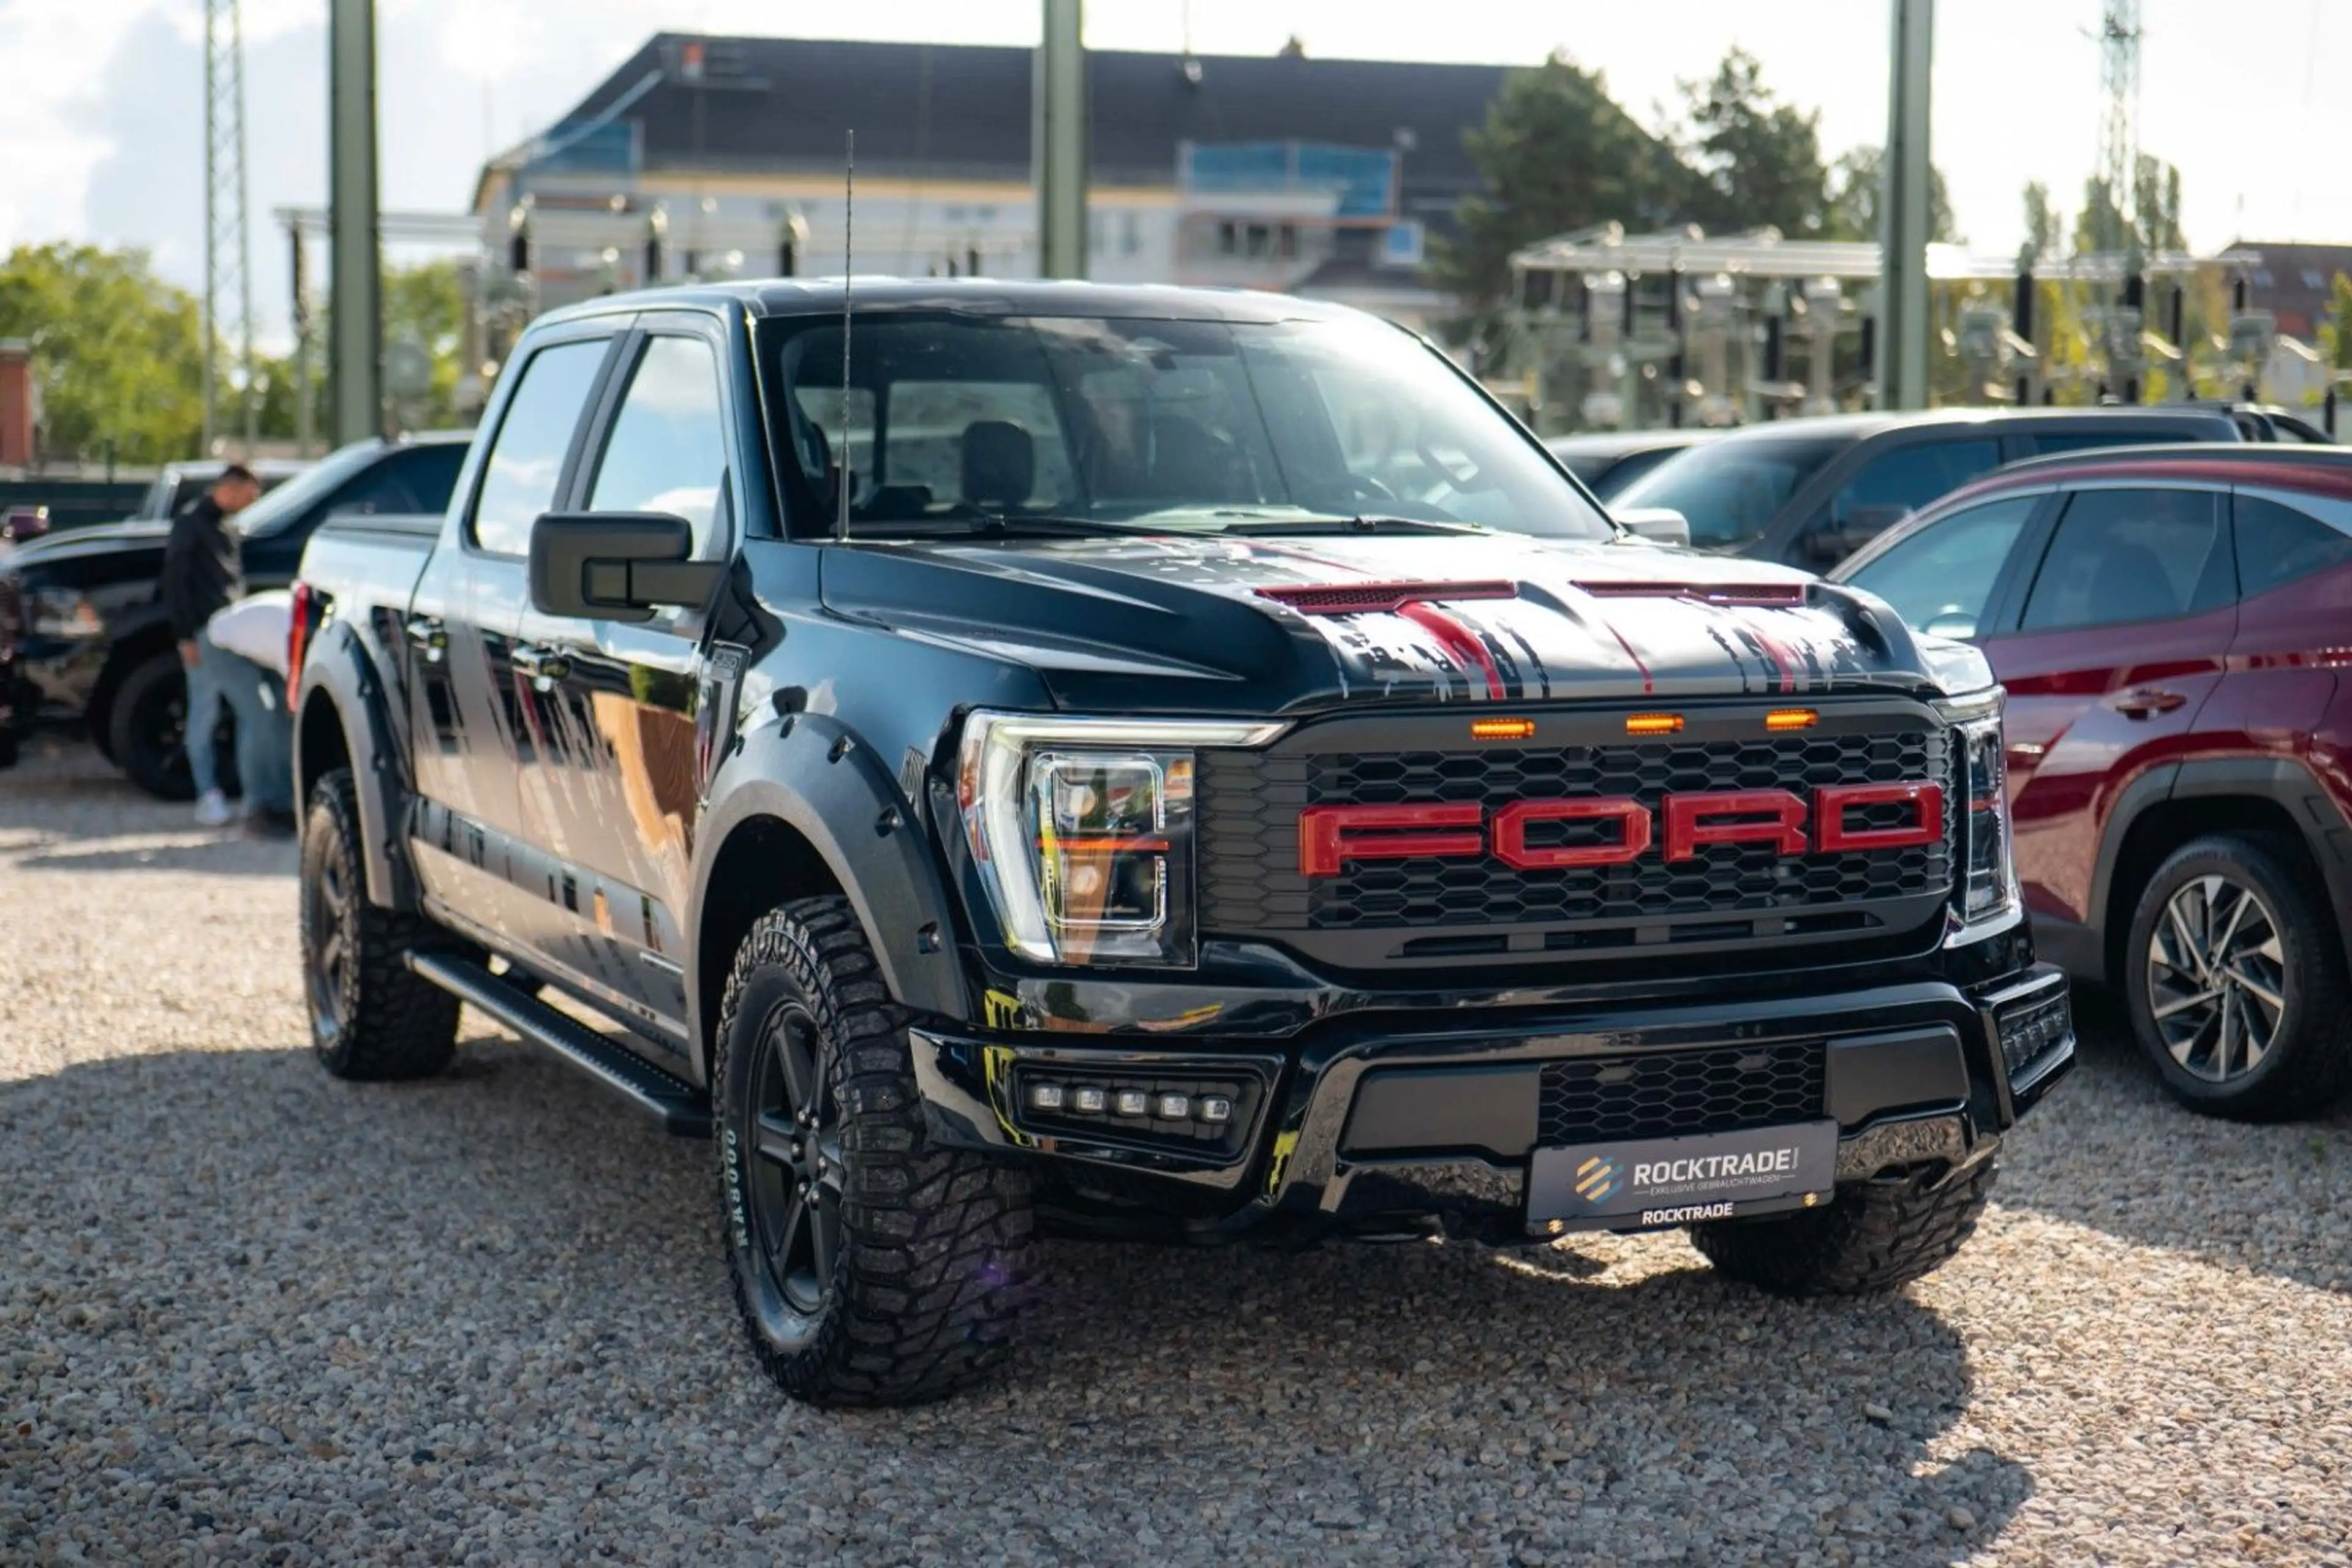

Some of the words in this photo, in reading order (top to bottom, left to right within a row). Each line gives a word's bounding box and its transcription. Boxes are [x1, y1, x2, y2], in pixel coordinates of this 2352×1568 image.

[1300, 780, 1943, 876] FORD
[1634, 1149, 1791, 1185] ROCKTRADE
[1642, 1202, 1734, 1224] ROCKTRADE
